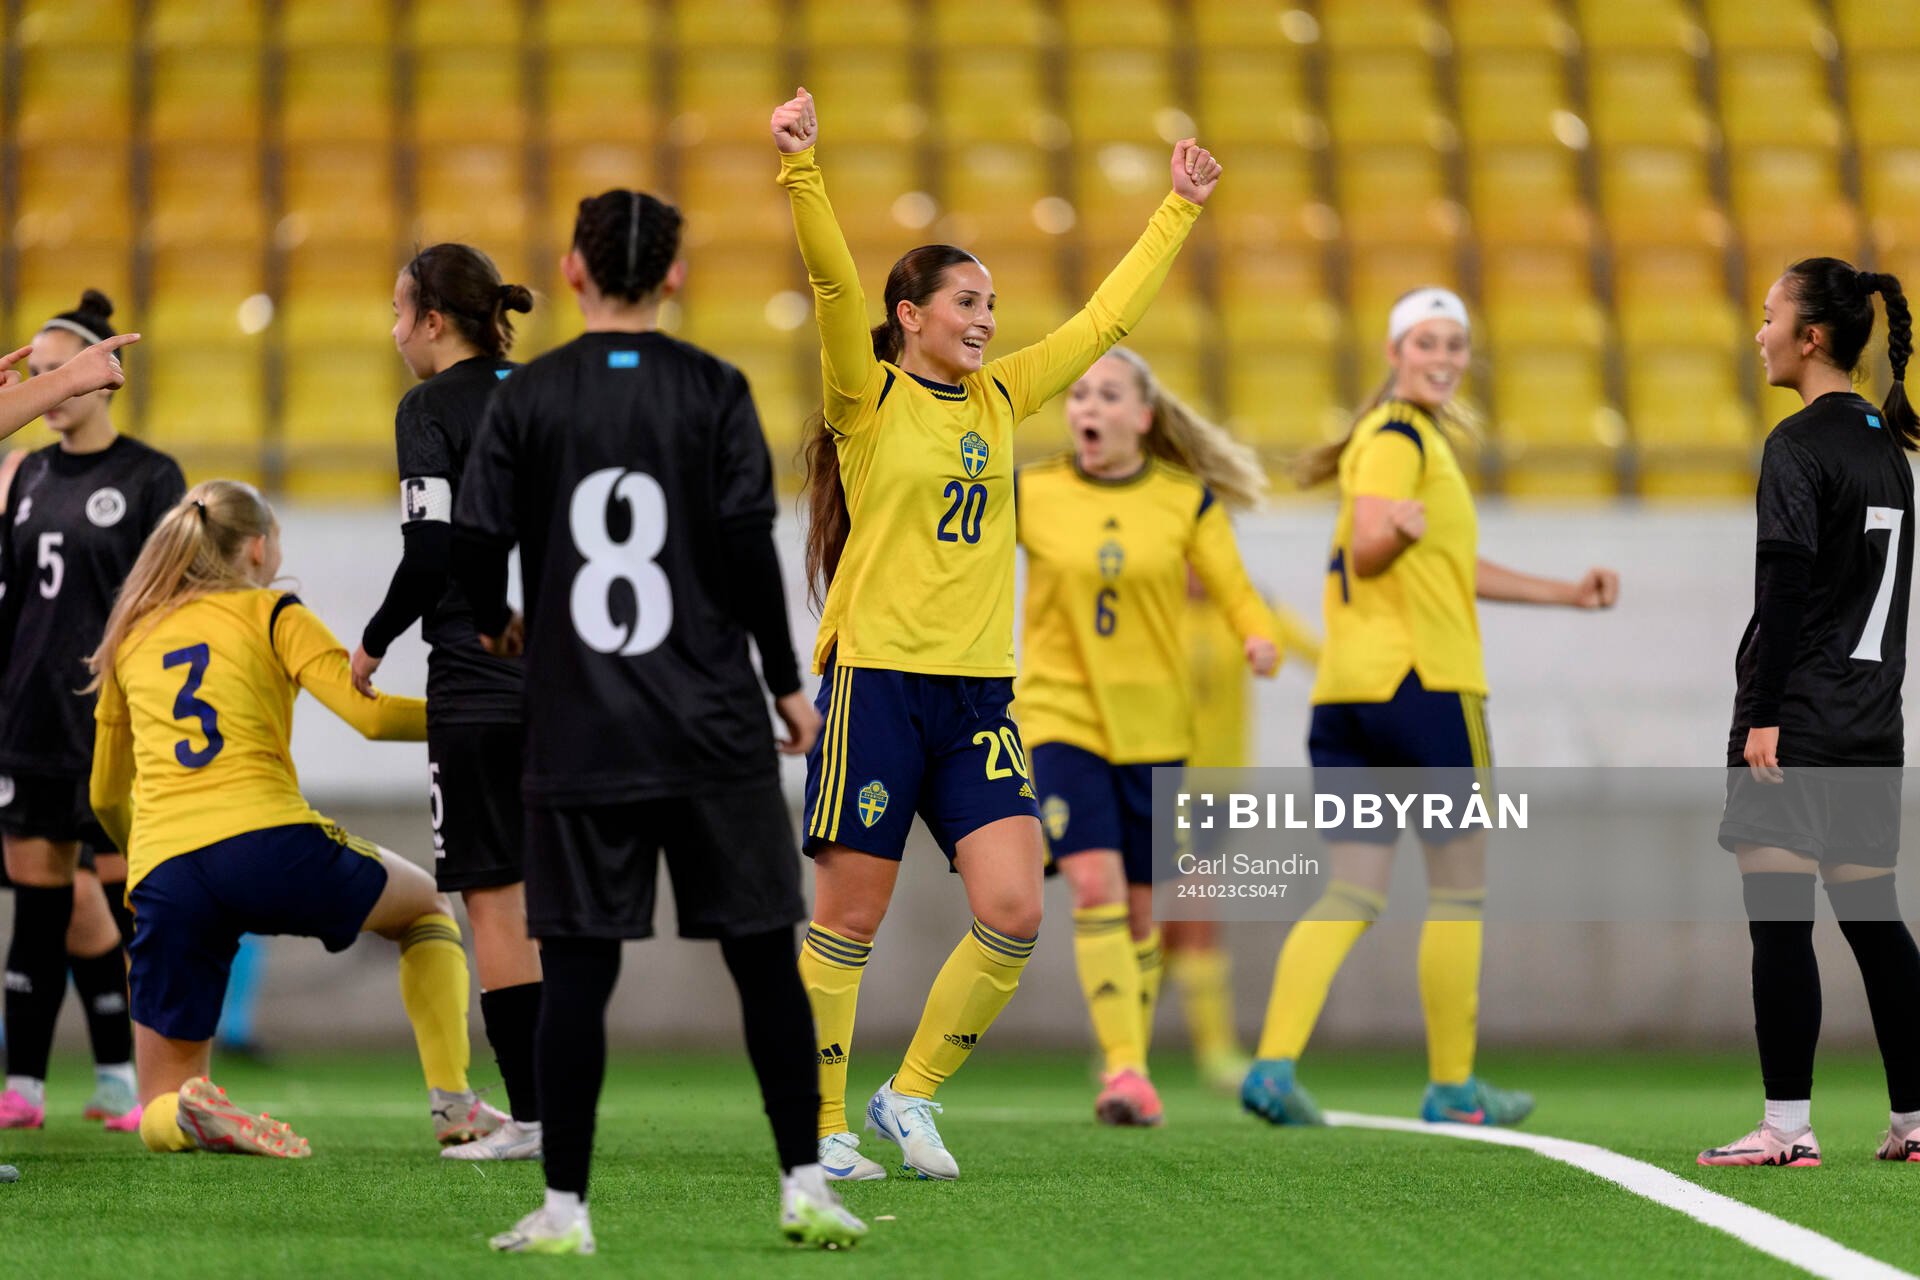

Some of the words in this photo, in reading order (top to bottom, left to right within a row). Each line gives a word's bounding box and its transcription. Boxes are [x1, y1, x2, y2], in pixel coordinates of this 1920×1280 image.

[407, 479, 426, 520] C
[937, 481, 987, 544] 20
[38, 531, 64, 599] 5
[569, 467, 673, 656] 8
[1849, 506, 1904, 662] 7
[1095, 586, 1118, 637] 6
[163, 643, 224, 768] 3
[972, 726, 1028, 780] 20
